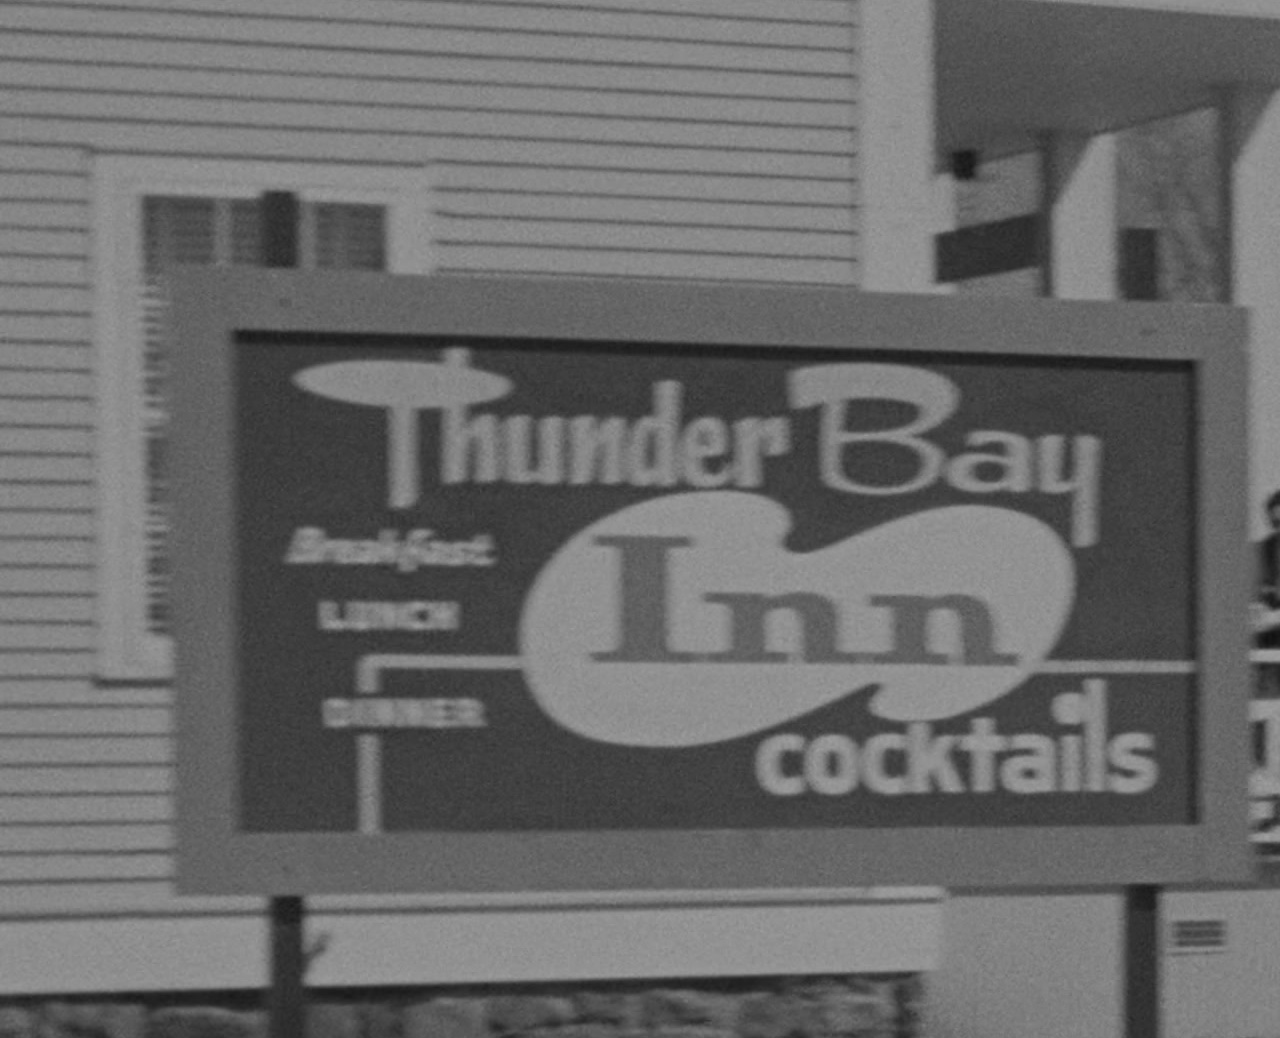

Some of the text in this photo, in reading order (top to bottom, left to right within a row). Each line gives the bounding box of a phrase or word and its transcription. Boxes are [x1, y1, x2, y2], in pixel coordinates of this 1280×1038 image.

[292, 347, 1101, 545] Thunder Bay
[285, 527, 497, 572] Breakfast
[317, 601, 460, 630] LUNCH
[591, 534, 1017, 665] Inn
[324, 697, 485, 728] DINNER
[756, 679, 1157, 795] cocktails
